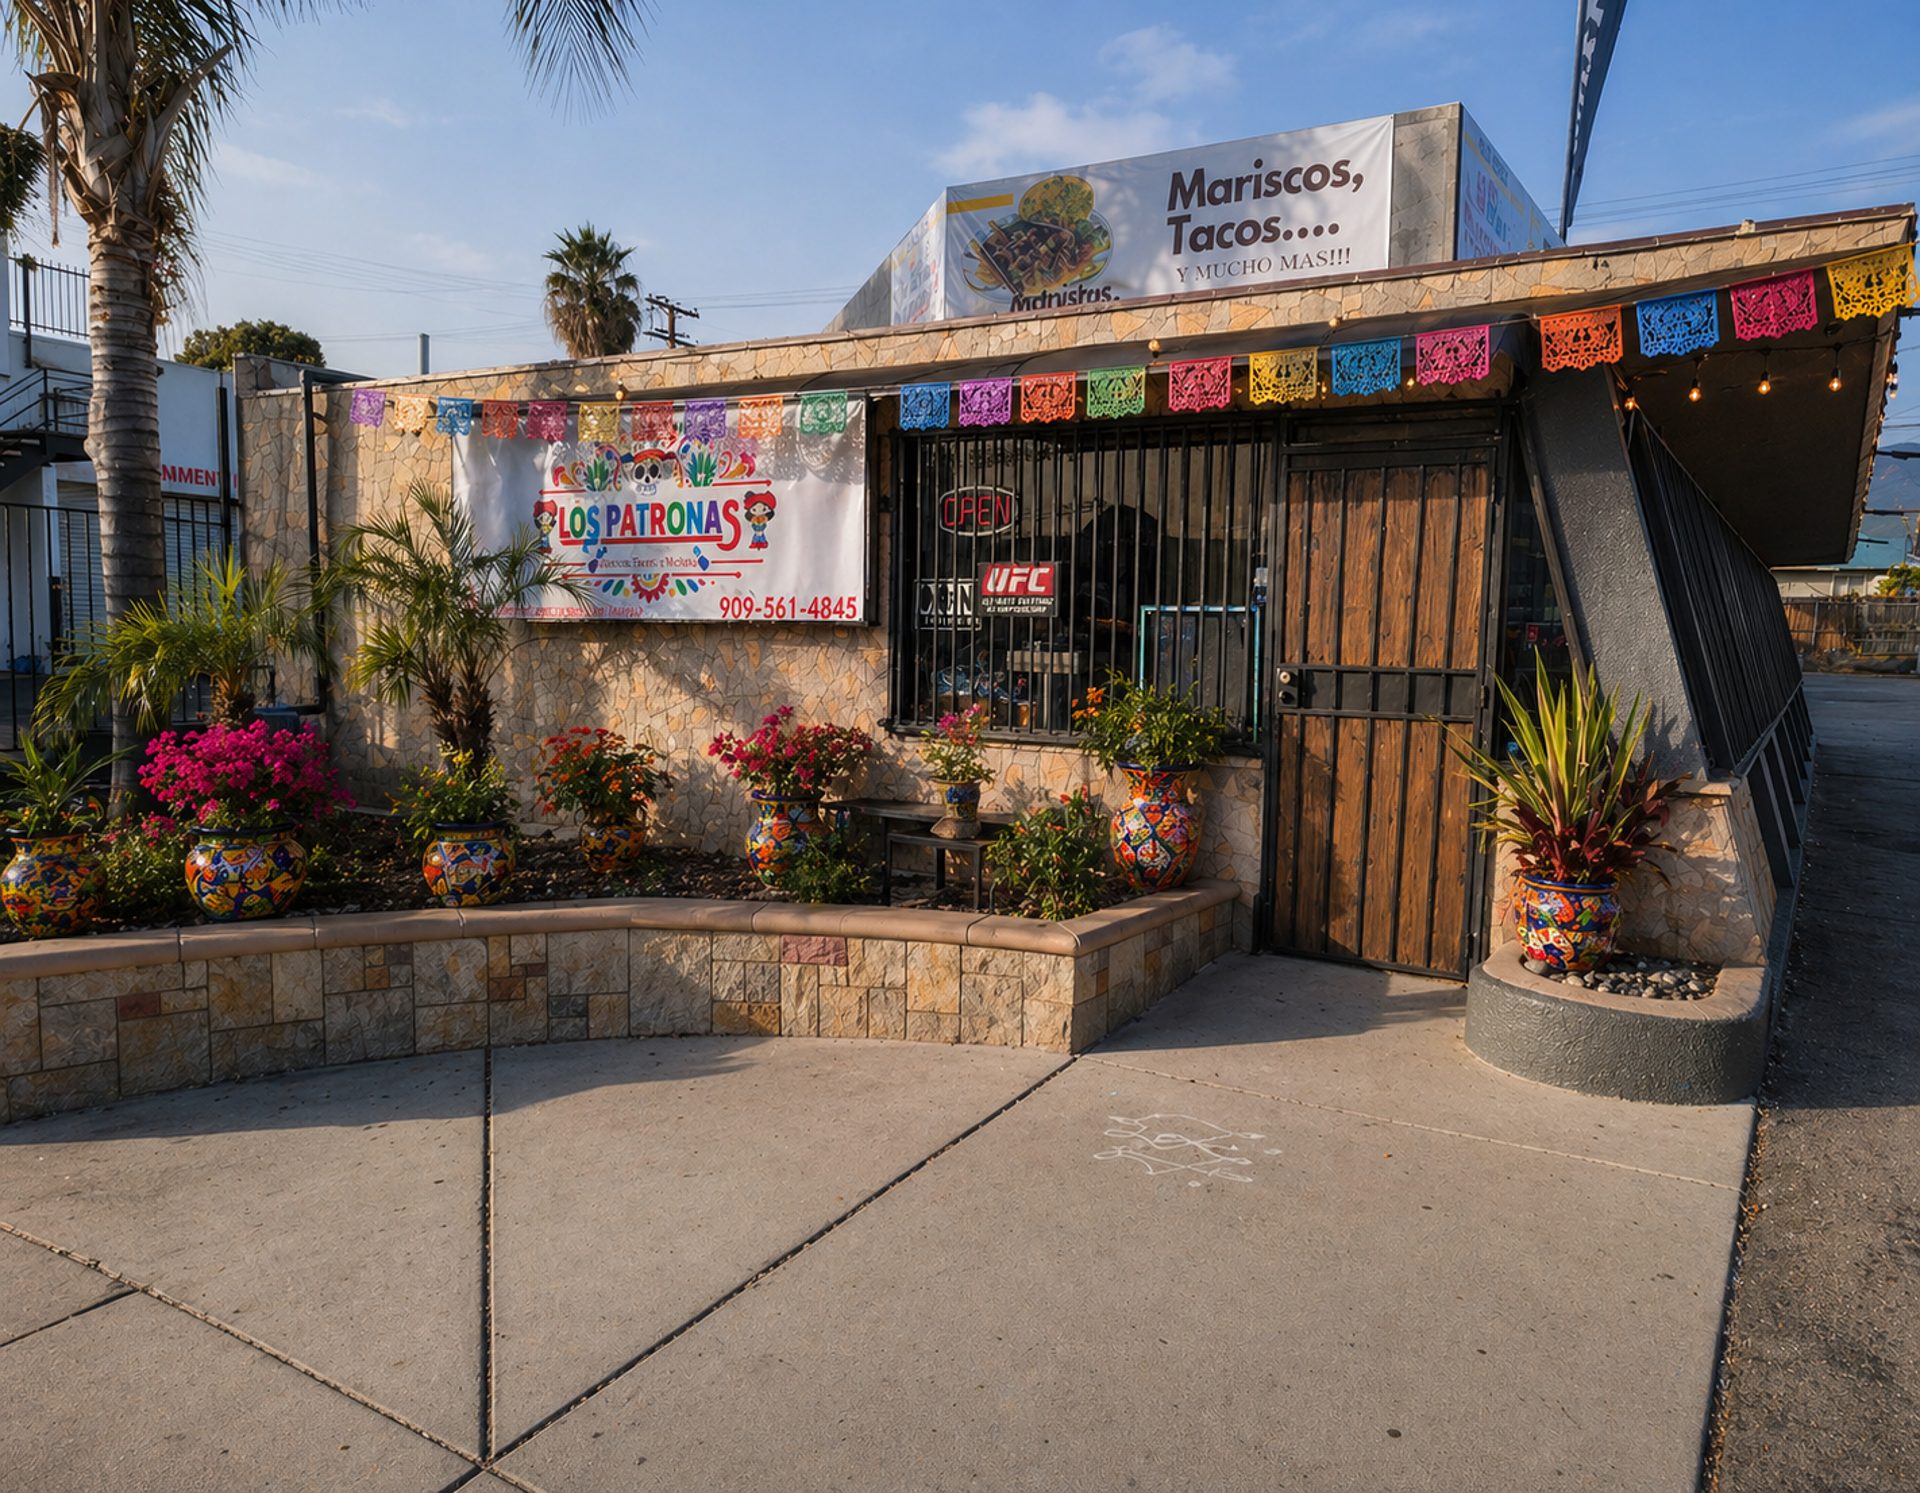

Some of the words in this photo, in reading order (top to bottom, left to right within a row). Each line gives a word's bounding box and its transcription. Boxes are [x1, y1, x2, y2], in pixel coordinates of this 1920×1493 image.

[1167, 158, 1364, 212] Mariscos,
[1166, 214, 1340, 255] Tacos....
[1176, 267, 1189, 282] Y
[1195, 257, 1272, 281] MUCHO
[1279, 247, 1351, 271] MAS!!!
[559, 505, 600, 546] LOS
[606, 499, 742, 551] PATRONAS
[943, 495, 1011, 527] OPEN
[986, 567, 1050, 593] UFC
[719, 596, 857, 619] 909-561-4845
